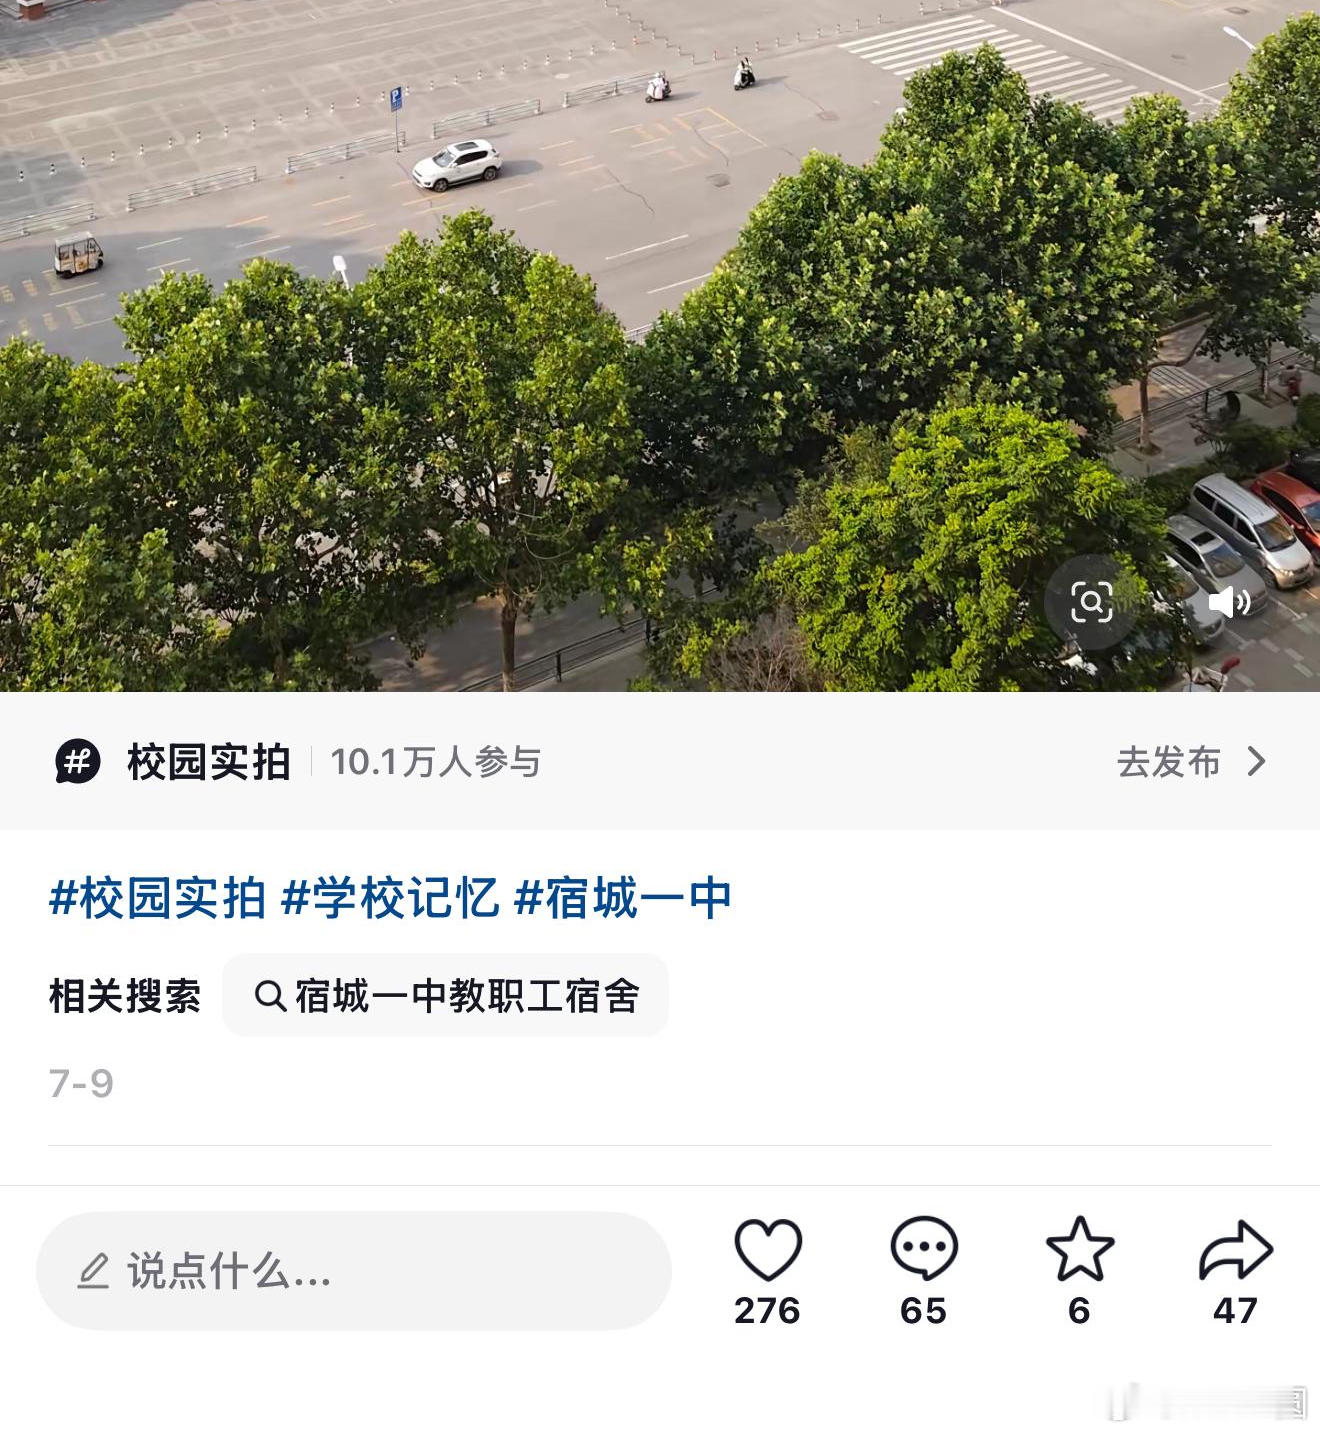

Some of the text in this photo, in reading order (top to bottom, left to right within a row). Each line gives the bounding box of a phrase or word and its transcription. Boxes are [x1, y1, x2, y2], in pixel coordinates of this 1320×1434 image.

[126, 741, 290, 782] 校园实拍
[331, 744, 541, 779] 10.1万人参与
[1116, 744, 1221, 779] 去发布
[48, 874, 731, 920] #校园实拍 #学校记忆 #宿城一中
[48, 976, 201, 1014] 相关搜索
[295, 976, 641, 1014] 宿城一中教职工宿舍
[49, 1068, 114, 1099] 7-9
[126, 1250, 331, 1291] 说点什么...
[734, 1296, 801, 1325] 276
[900, 1296, 947, 1325] 65
[1068, 1296, 1091, 1325] 6
[1213, 1296, 1258, 1324] 47
